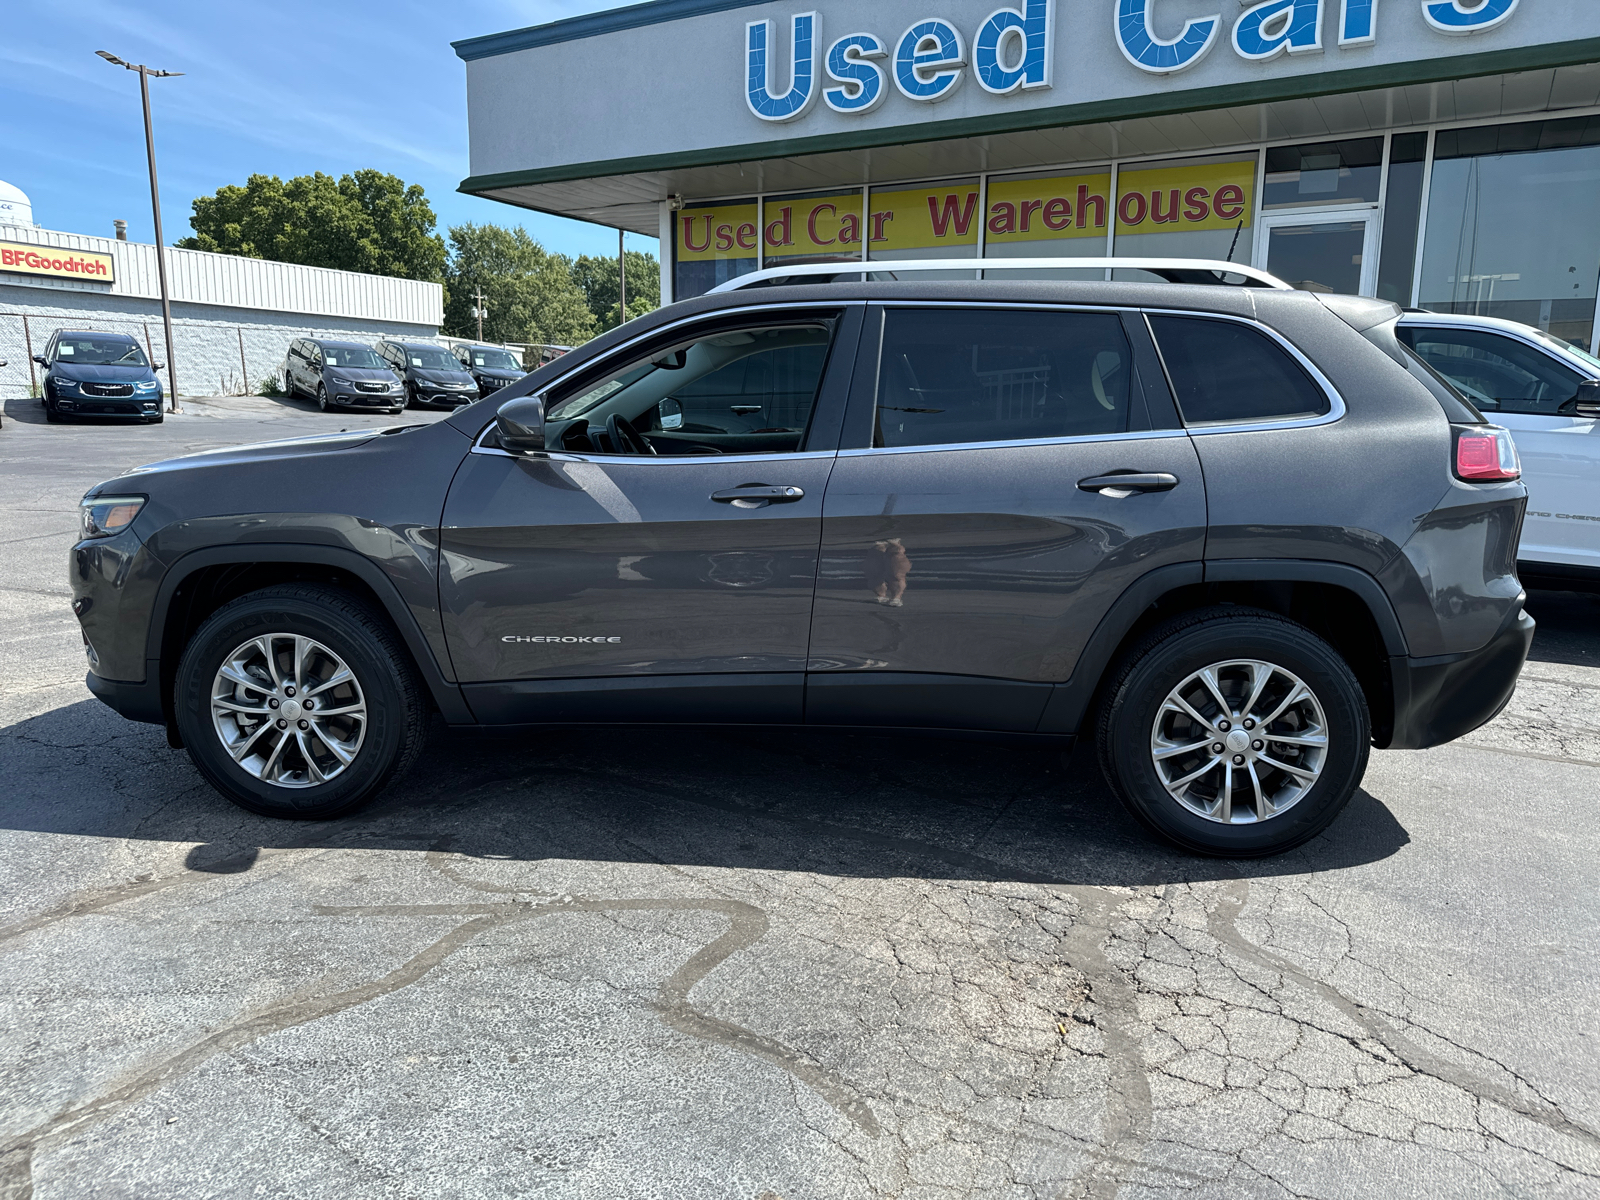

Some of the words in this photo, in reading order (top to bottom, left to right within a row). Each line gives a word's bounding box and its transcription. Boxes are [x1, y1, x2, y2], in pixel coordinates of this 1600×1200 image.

[745, 0, 1055, 122] Used
[681, 206, 795, 252] Used
[807, 203, 893, 245] Car
[927, 184, 1245, 238] Warehouse
[1, 248, 107, 275] BFGoodrich
[501, 635, 622, 644] CHEROKEE
